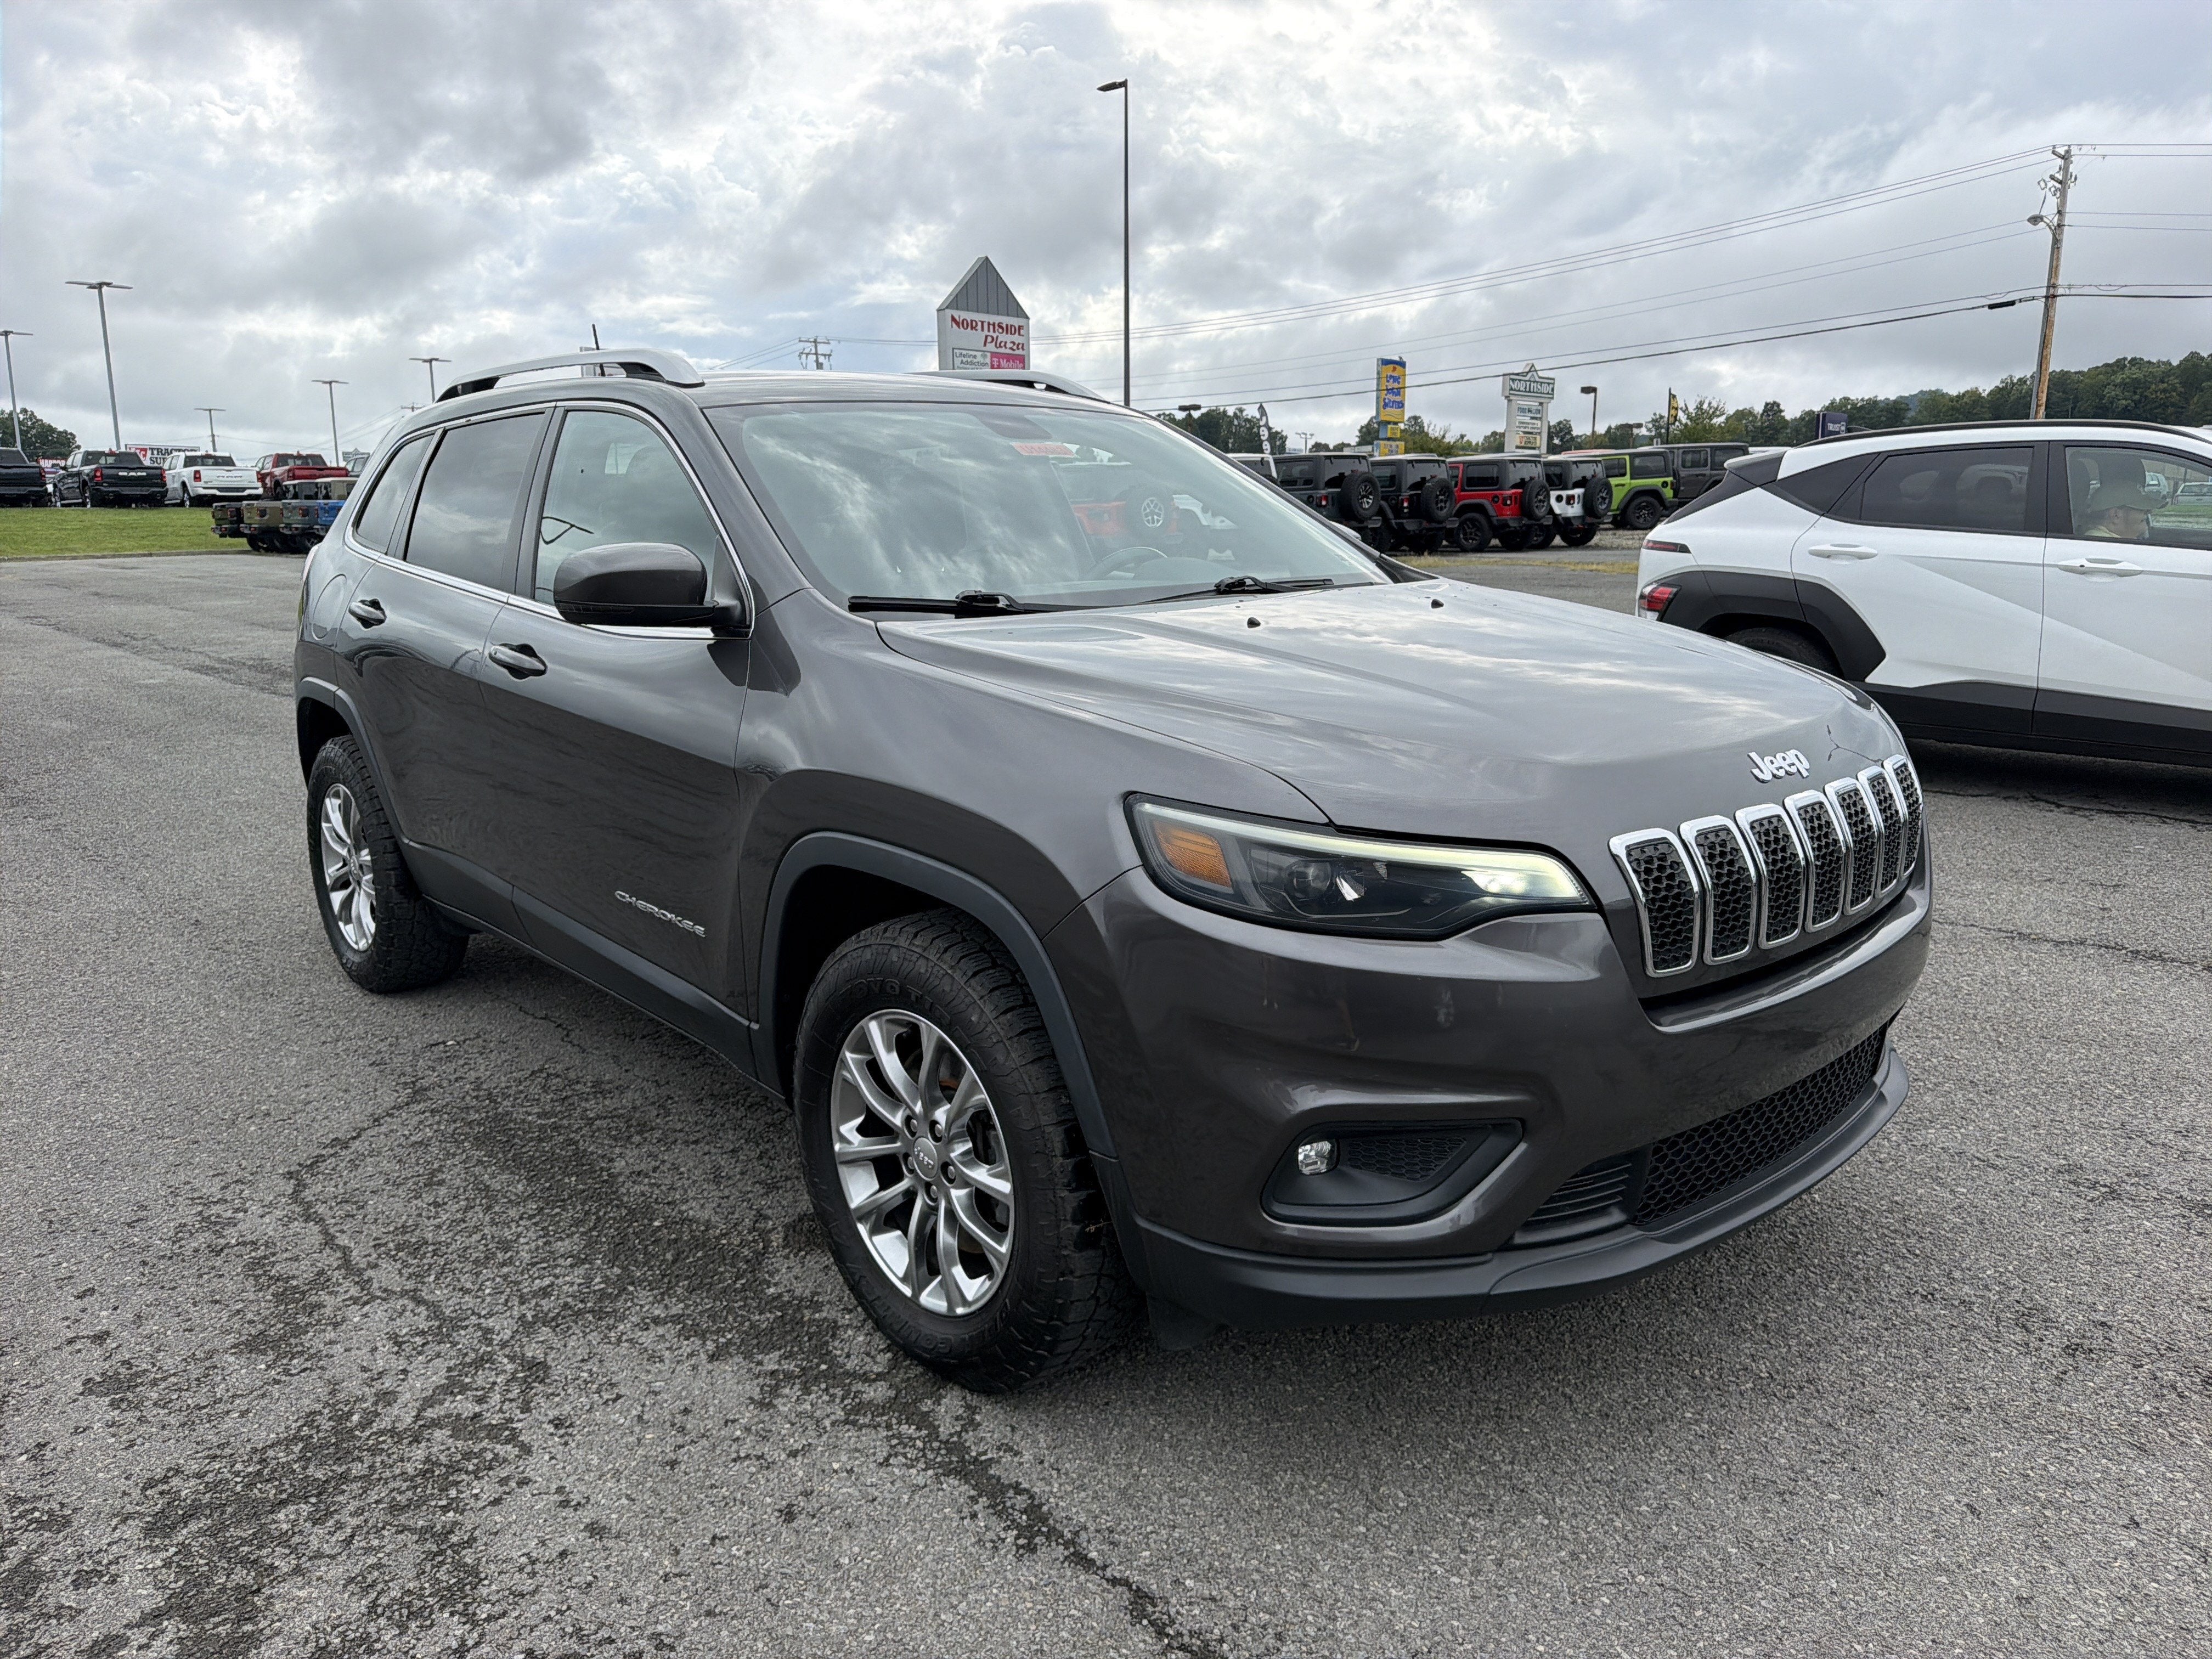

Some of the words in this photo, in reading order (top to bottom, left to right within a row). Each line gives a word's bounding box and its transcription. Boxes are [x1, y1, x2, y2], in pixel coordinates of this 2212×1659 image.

[951, 314, 1024, 337] NORTHSIDE
[983, 334, 1025, 352] Plaza
[960, 359, 989, 367] Addiction
[1000, 358, 1024, 369] Mobile
[1510, 379, 1554, 394] NORTHSIDE
[1747, 749, 1810, 783] Jeep
[614, 890, 706, 938] CHEROKEE
